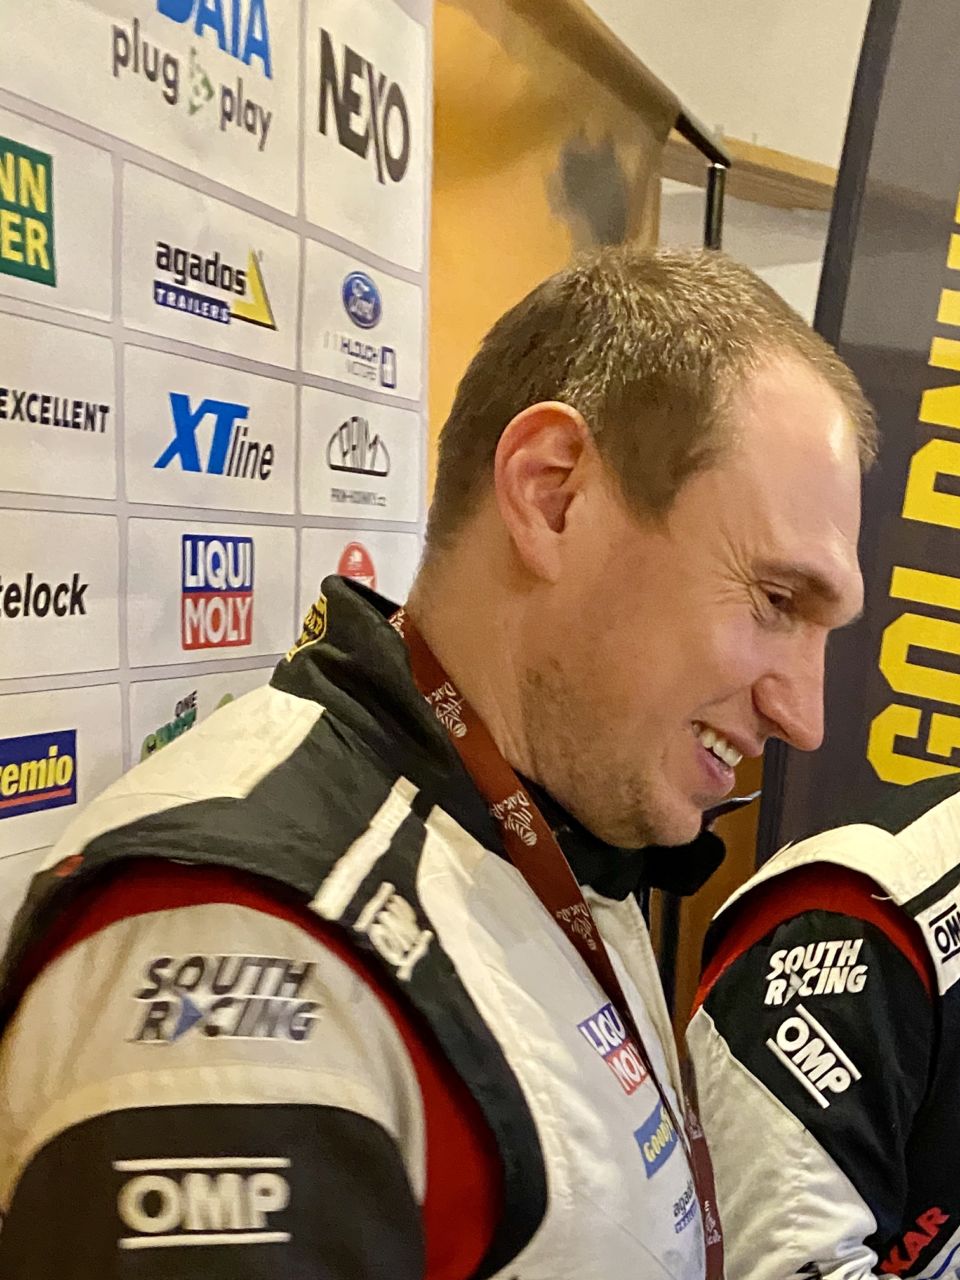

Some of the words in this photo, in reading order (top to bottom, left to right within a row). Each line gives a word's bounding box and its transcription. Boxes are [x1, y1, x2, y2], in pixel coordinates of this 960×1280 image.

[112, 17, 179, 105] plug
[220, 76, 272, 152] play
[319, 27, 411, 184] NEXO
[156, 241, 247, 296] agados
[156, 288, 229, 322] TRAILERS
[0, 388, 110, 432] EXCELLENT
[184, 540, 252, 590] LIQUI
[0, 572, 89, 618] elock
[185, 596, 252, 647] MOLY
[0, 745, 73, 796] emio
[136, 955, 316, 999] SOUTH
[766, 938, 864, 980] SOUTH
[775, 1016, 852, 1095] OMP
[116, 1174, 291, 1234] OMP
